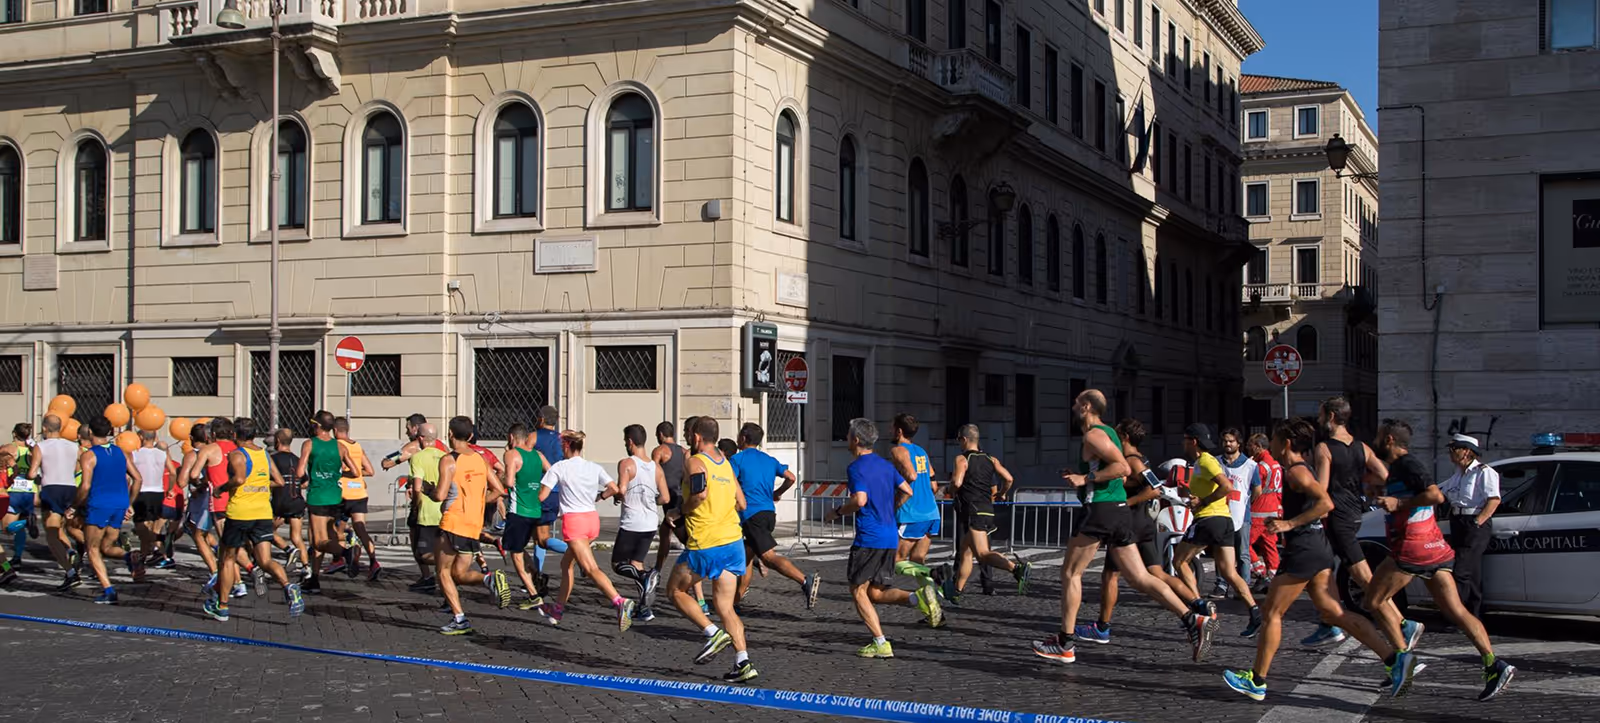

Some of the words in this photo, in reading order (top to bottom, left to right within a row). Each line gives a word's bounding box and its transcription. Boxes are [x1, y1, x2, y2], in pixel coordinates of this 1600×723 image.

[1486, 538, 1521, 551] OMA
[1523, 535, 1588, 550] CAPITALE
[729, 686, 757, 697] ROME
[774, 690, 829, 704] 23092018
[831, 695, 864, 709] PACIS
[864, 697, 882, 711] VIA
[884, 700, 944, 717] MARATHON
[946, 705, 978, 720] HALF
[978, 708, 1011, 723] ROME
